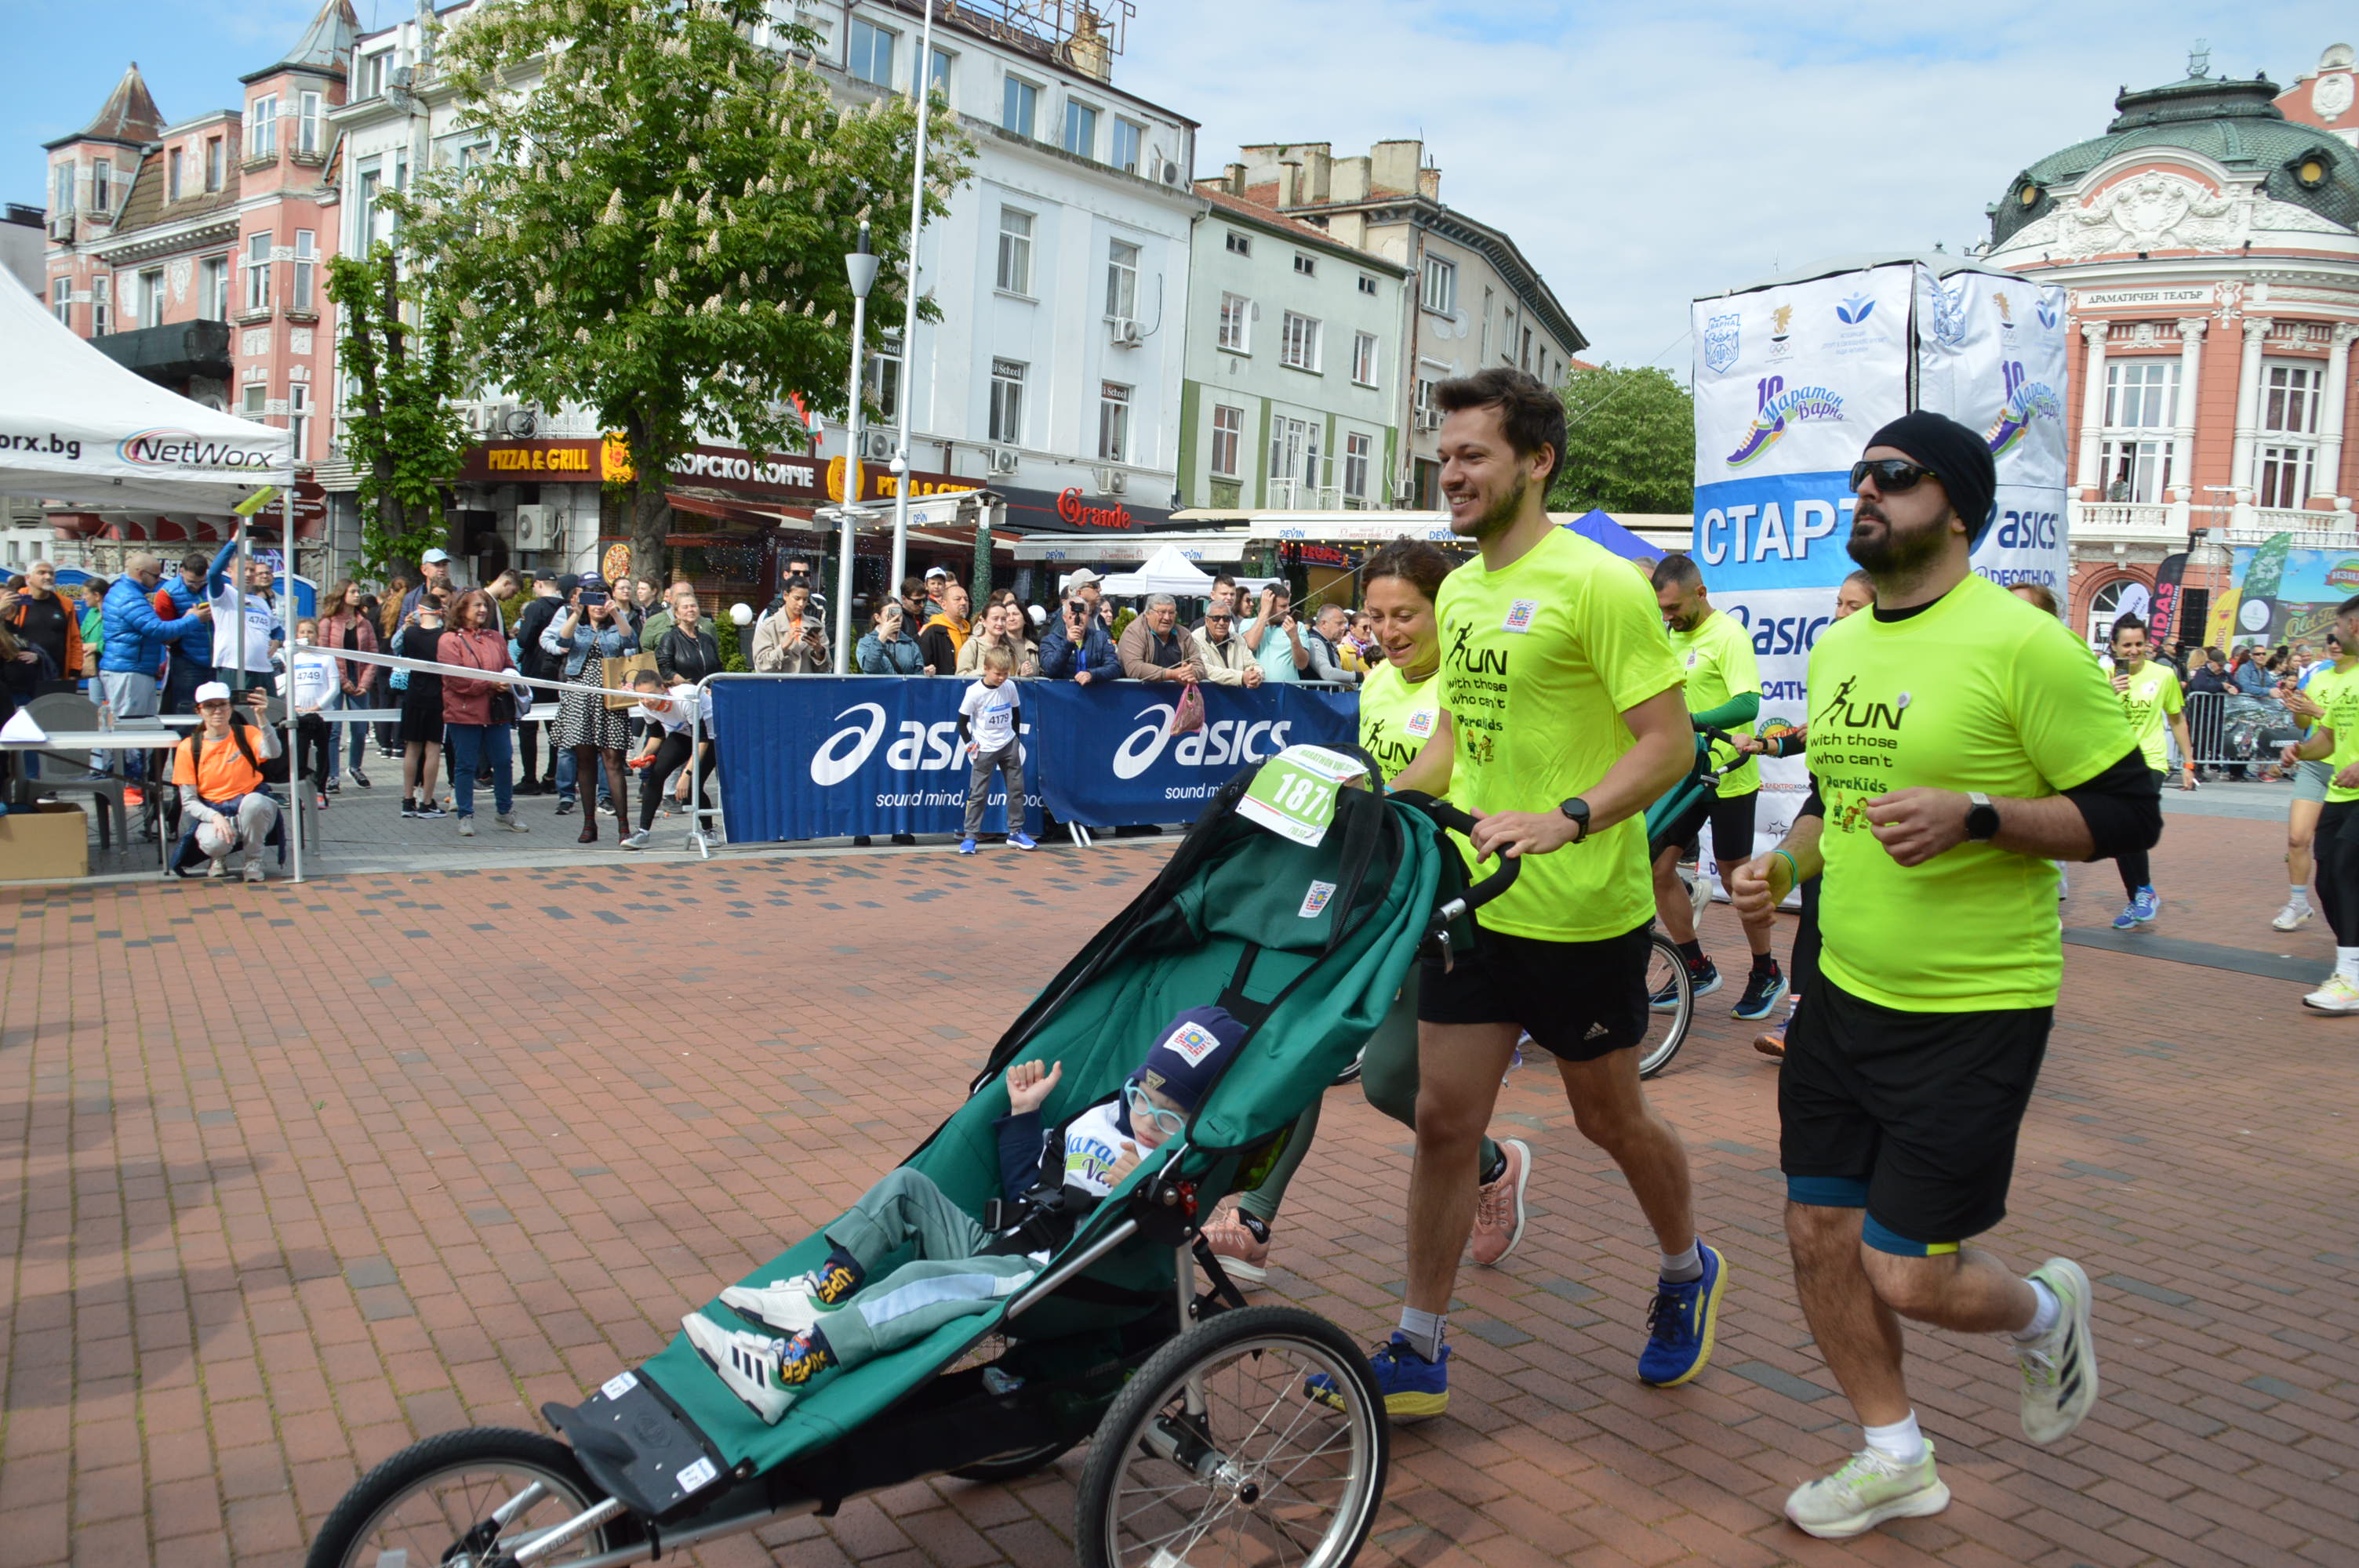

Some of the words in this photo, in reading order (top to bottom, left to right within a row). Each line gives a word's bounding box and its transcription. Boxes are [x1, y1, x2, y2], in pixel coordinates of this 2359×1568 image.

[2088, 292, 2159, 304] ДРАМАТИЧЕН
[2163, 290, 2204, 301] ТЕАТЪР
[1763, 386, 1844, 427] Маратон
[1795, 400, 1844, 421] Варна
[133, 437, 274, 468] NetWorx
[489, 449, 530, 470] PIZZA
[532, 449, 546, 470] &
[547, 448, 591, 470] GRILL
[1057, 487, 1132, 529] Grande
[1280, 529, 1306, 539] DEVIN
[1700, 497, 1856, 565] СТАР
[1045, 550, 1066, 560] DEVIN
[1752, 616, 1835, 655] asic
[296, 670, 321, 681] 4749
[1447, 677, 1471, 689] with
[1474, 678, 1508, 692] those
[1451, 693, 1476, 706] who
[988, 713, 1010, 725] 4179
[1810, 733, 1841, 747] with
[1847, 734, 1898, 750] those
[1813, 752, 1845, 765] who
[1848, 753, 1894, 768] can't
[875, 789, 921, 808] sound
[924, 789, 965, 808] mind,
[1165, 783, 1200, 800] sound
